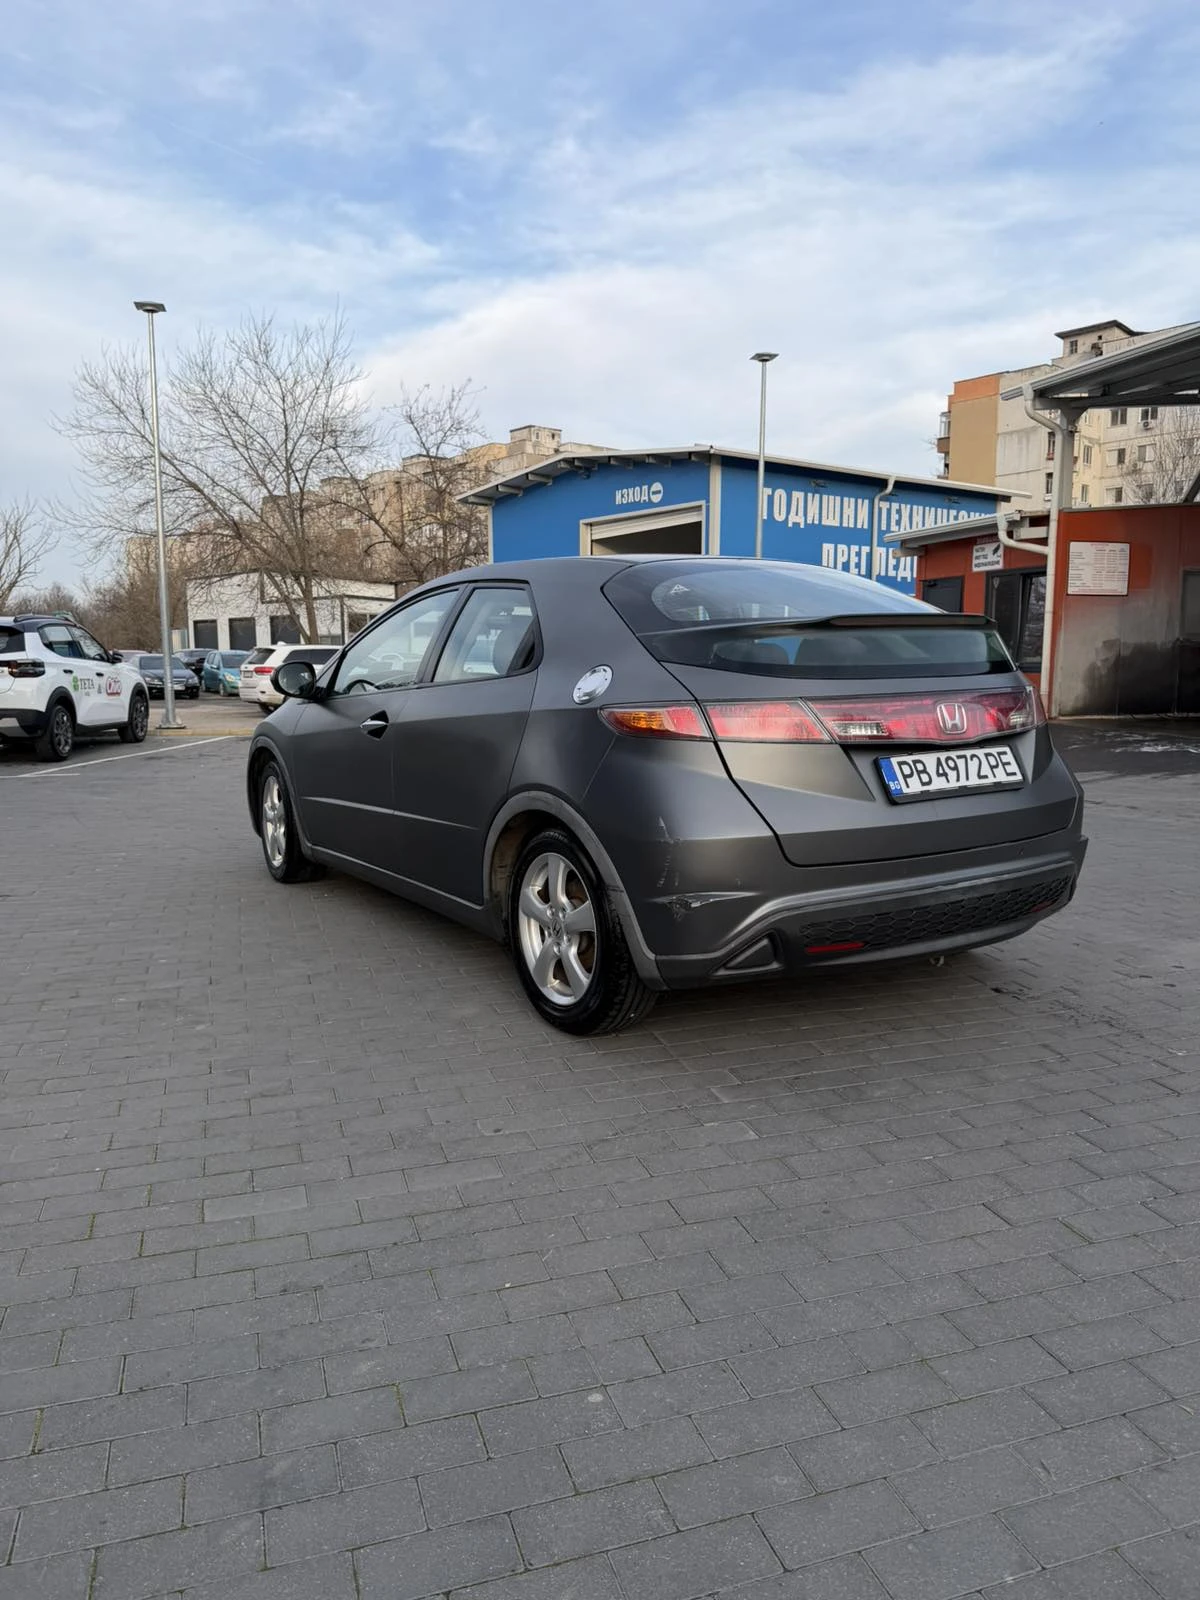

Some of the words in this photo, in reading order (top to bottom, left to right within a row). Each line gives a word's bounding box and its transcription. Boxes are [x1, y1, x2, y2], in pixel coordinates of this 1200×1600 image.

[615, 484, 649, 505] ИЗХОД
[762, 487, 870, 529] ГОДИШНИ
[889, 780, 901, 790] BG
